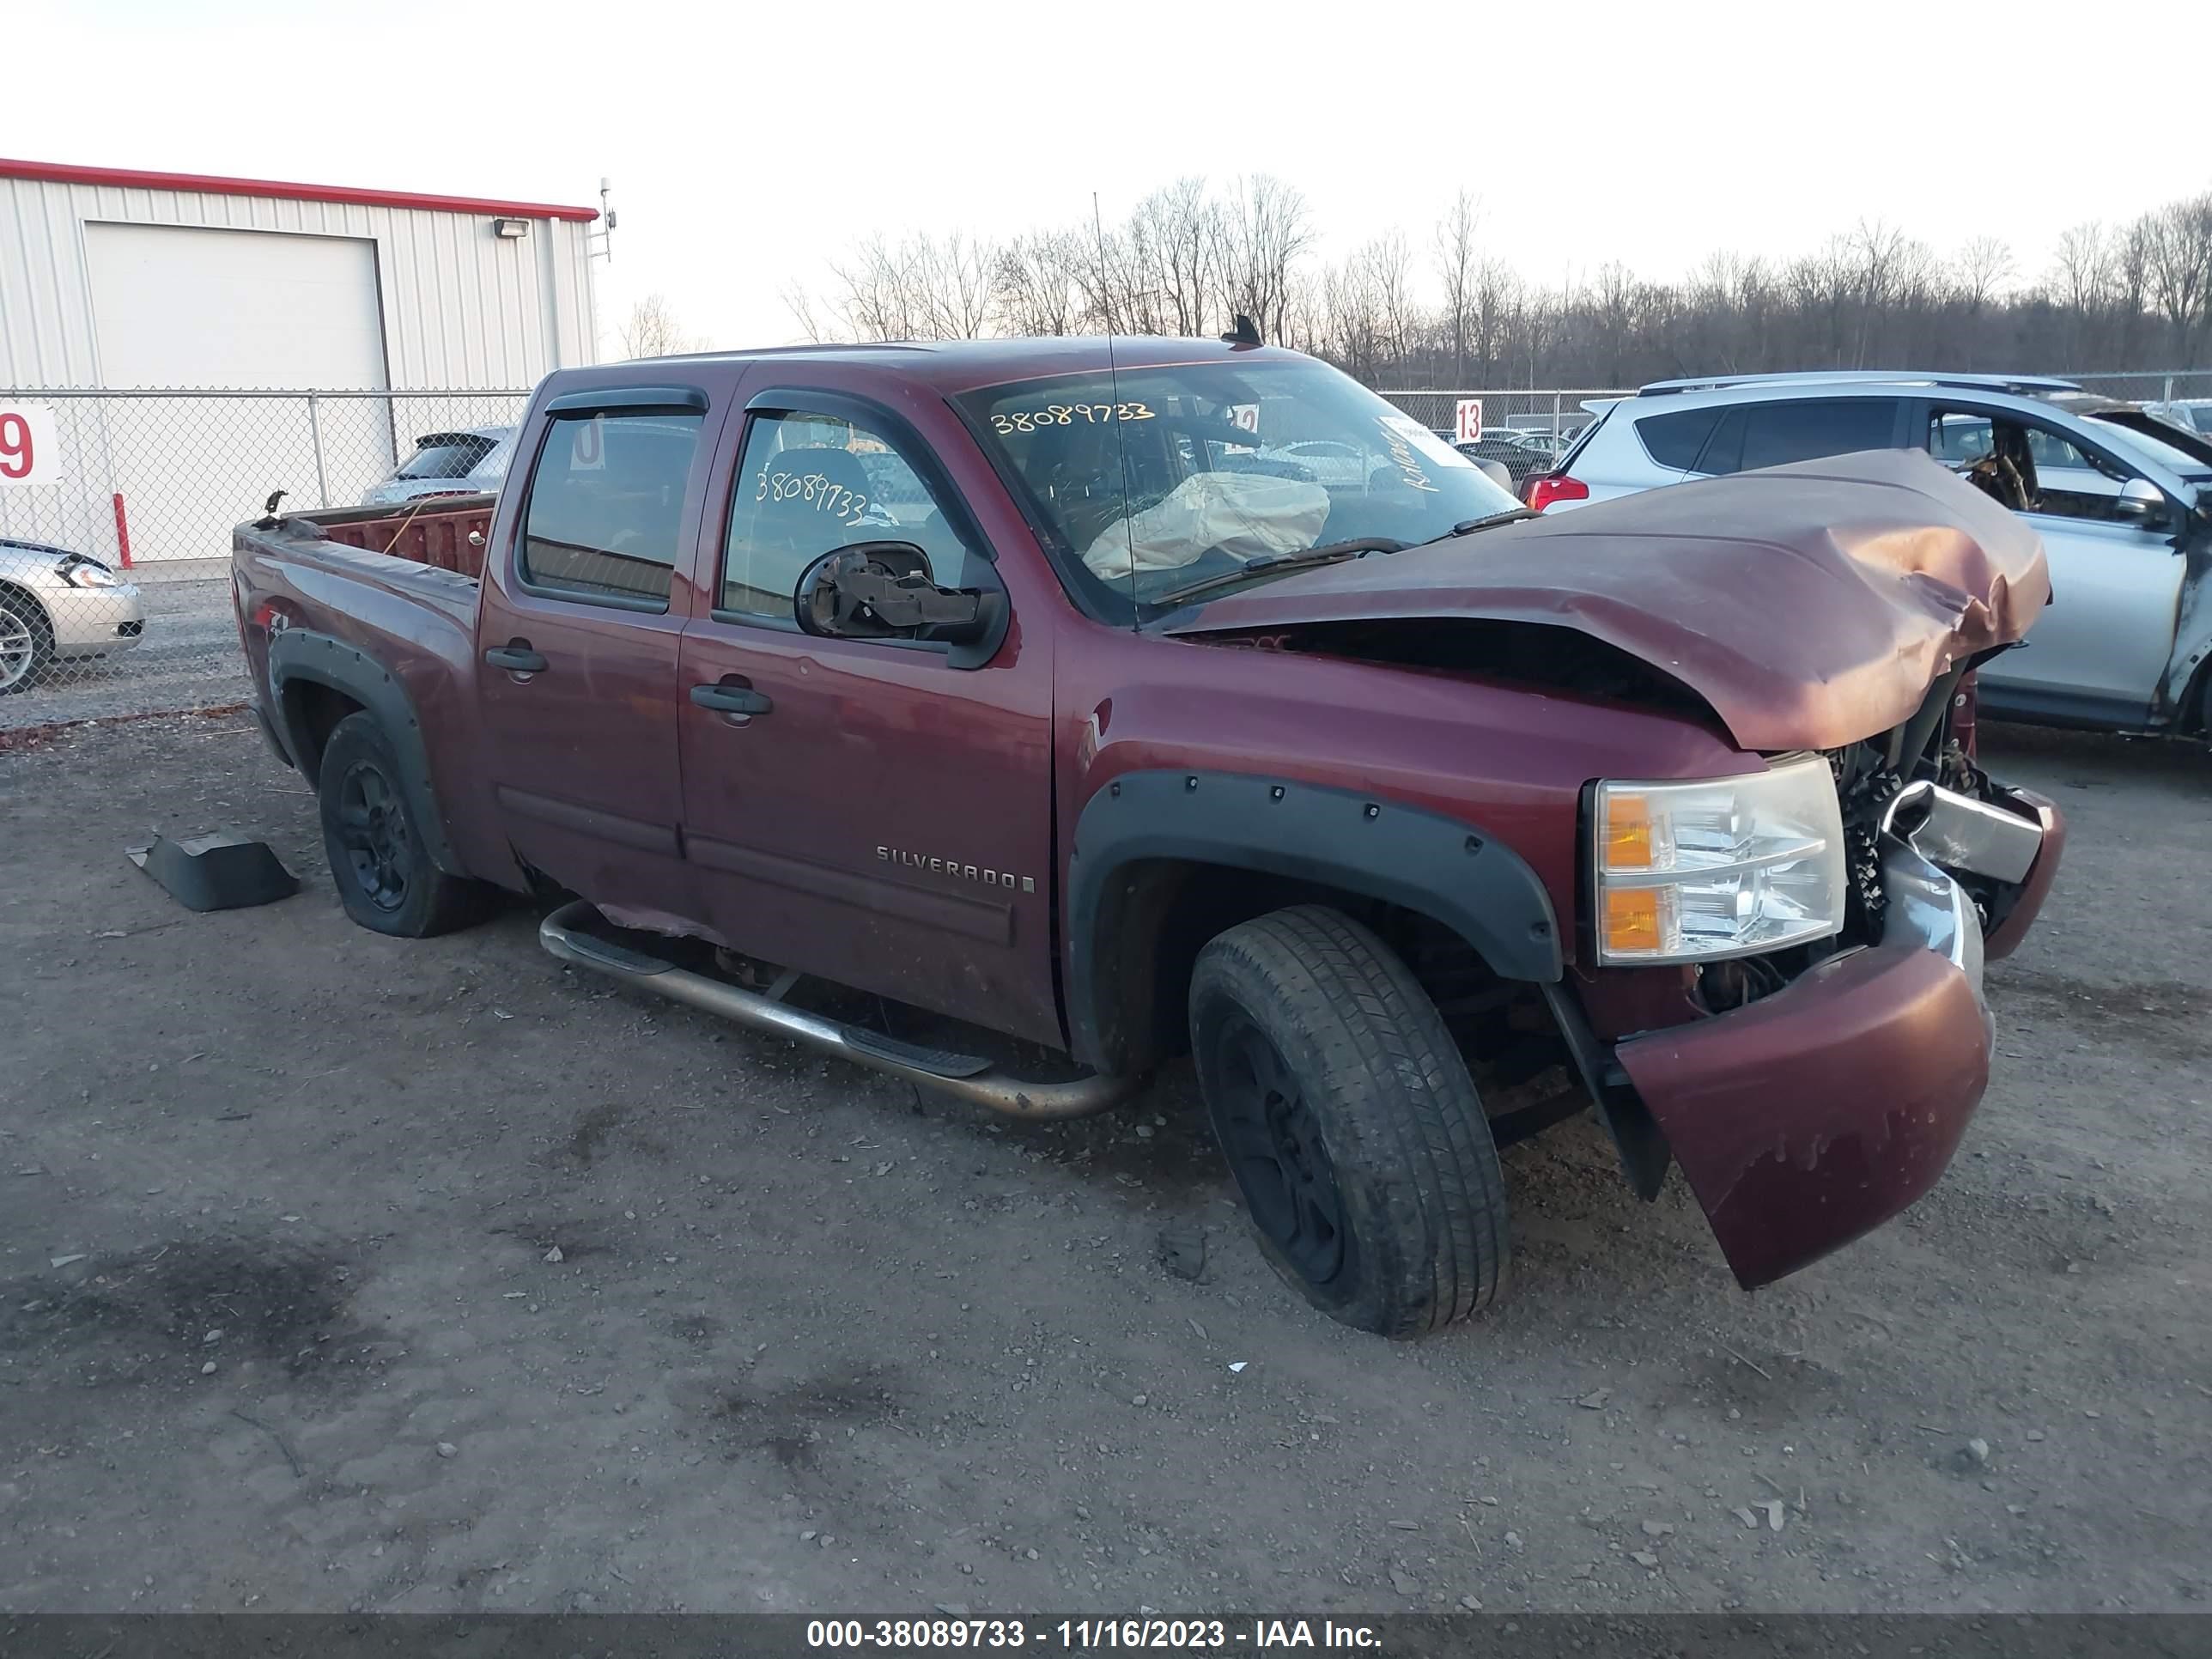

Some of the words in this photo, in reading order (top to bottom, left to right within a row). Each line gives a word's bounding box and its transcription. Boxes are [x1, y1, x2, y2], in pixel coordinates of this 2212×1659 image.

[990, 402, 1157, 435] 38089733
[1459, 404, 1480, 439] 13
[0, 412, 33, 478] 9
[756, 472, 866, 526] 38089733
[876, 845, 1016, 890] SILVERADO
